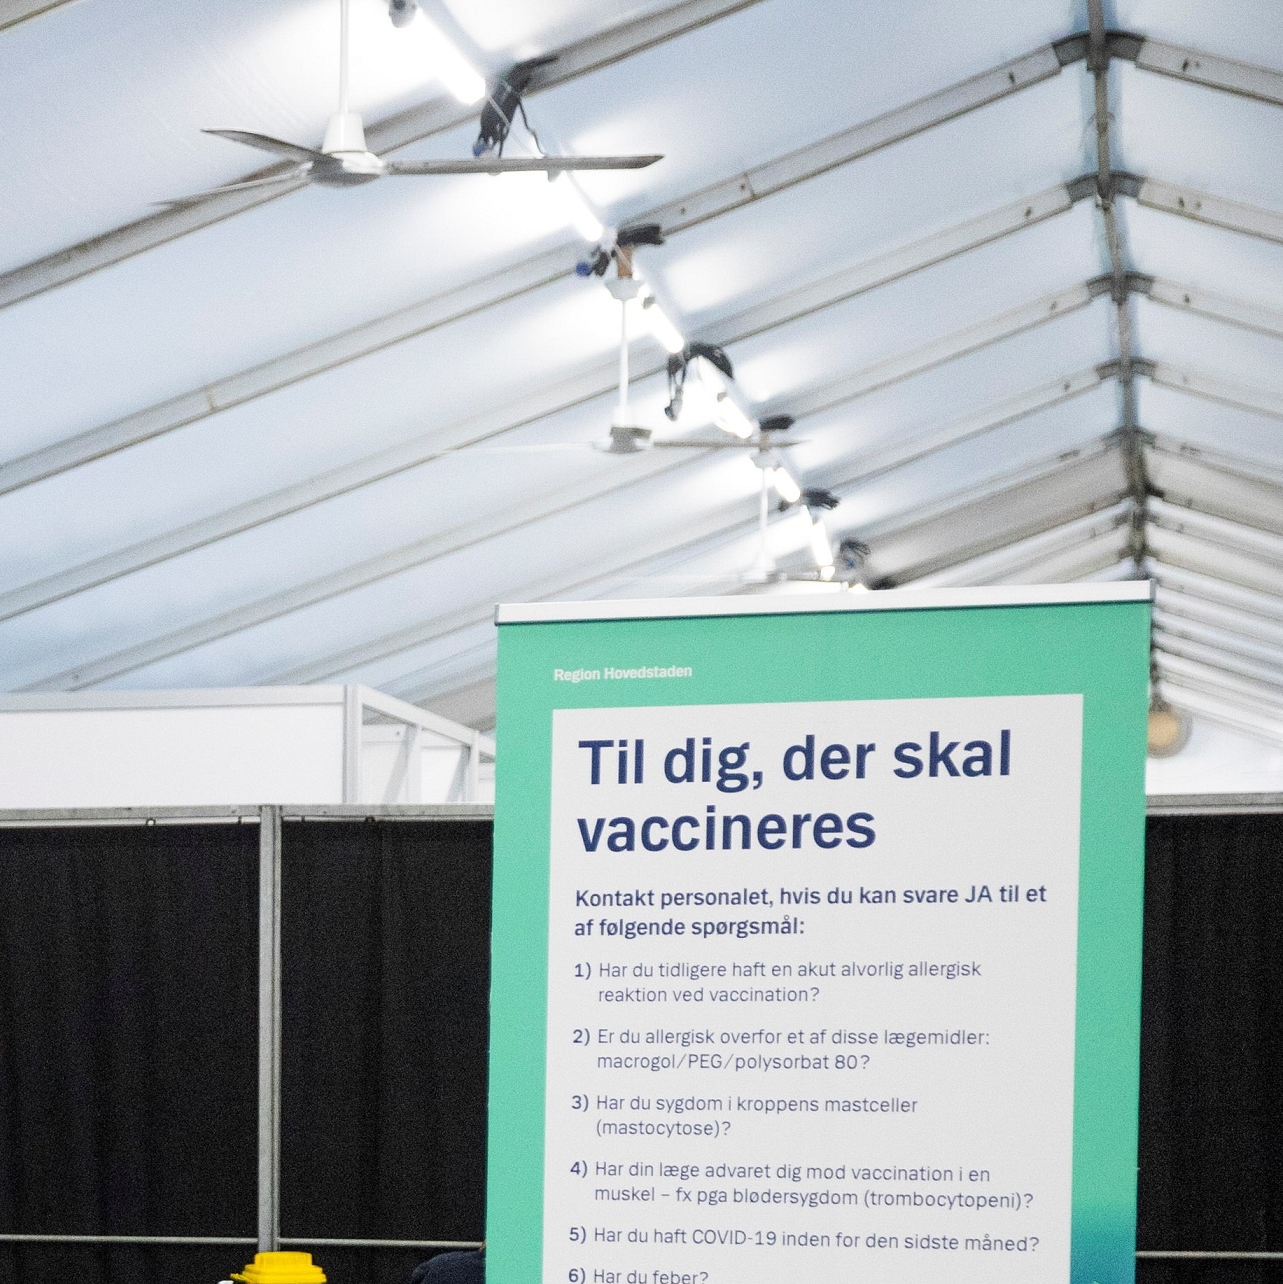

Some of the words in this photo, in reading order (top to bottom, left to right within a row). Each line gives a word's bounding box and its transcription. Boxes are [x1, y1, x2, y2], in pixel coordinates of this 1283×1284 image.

[552, 667, 602, 684] Region
[603, 664, 693, 680] Hovedstaden
[578, 738, 644, 785] Til
[663, 737, 764, 794] dig,
[782, 734, 876, 782] der
[892, 729, 1011, 779] skal
[576, 804, 876, 853] vaccineres
[575, 887, 655, 907] Kontakt
[660, 887, 774, 911] personalet,
[780, 887, 822, 905] hvis
[826, 886, 853, 905] du
[859, 886, 897, 905] kan
[902, 889, 959, 904] svare
[964, 884, 993, 904] JA
[998, 884, 1020, 903] til
[1025, 885, 1047, 903] et
[574, 918, 594, 937] af
[598, 917, 686, 941] følgende
[691, 914, 805, 939] spørgsmål:
[574, 961, 592, 981] 1)
[598, 962, 628, 978] Har
[632, 962, 654, 978] du
[658, 962, 728, 981] tidligere
[732, 961, 766, 978] haft
[770, 964, 793, 977] en
[797, 961, 836, 977] akut
[840, 961, 904, 981] alvorlig
[908, 961, 982, 981] allergisk
[598, 987, 668, 1003] reaktion
[672, 987, 704, 1003] ved
[708, 986, 820, 1003] vaccination?
[572, 1027, 591, 1047] 2)
[598, 1028, 615, 1044] Er
[619, 1029, 641, 1045] du
[645, 1029, 715, 1048] allergisk
[720, 1028, 783, 1045] overfor
[786, 1029, 805, 1045] et
[809, 1028, 828, 1045] af
[831, 1029, 879, 1045] disse
[884, 1029, 990, 1049] lægemidler:
[834, 1053, 871, 1071] 80?
[571, 1093, 590, 1113] 3)
[596, 1095, 626, 1111] Har
[629, 1095, 651, 1111] du
[655, 1095, 723, 1115] sygdom
[736, 1096, 820, 1115] kroppens
[824, 1097, 918, 1113] mastceller
[596, 1119, 732, 1139] (mastocytose)?
[569, 1159, 588, 1179] 4)
[595, 1161, 624, 1177] Har
[628, 1161, 654, 1177] din
[659, 1161, 700, 1181] læge
[704, 1163, 772, 1179] advaret
[776, 1163, 802, 1183] dig
[806, 1164, 846, 1181] mod
[850, 1165, 954, 1182] vaccination
[968, 1169, 990, 1183] en
[594, 1186, 655, 1202] muskel
[675, 1186, 692, 1203] fx
[696, 1189, 728, 1207] pga
[732, 1187, 858, 1209] blødersygdom
[863, 1189, 1034, 1212] (trombocytopeni)?
[568, 1225, 587, 1245] 5)
[594, 1227, 623, 1243] Har
[627, 1227, 649, 1244] du
[653, 1228, 687, 1245] haft
[692, 1228, 777, 1247] COVID-19
[782, 1231, 831, 1247] inden
[834, 1231, 861, 1248] for
[864, 1233, 899, 1249] den
[904, 1233, 960, 1251] sidste
[964, 1233, 1040, 1253] måned?
[593, 1268, 622, 1284] Har
[626, 1269, 648, 1284] du
